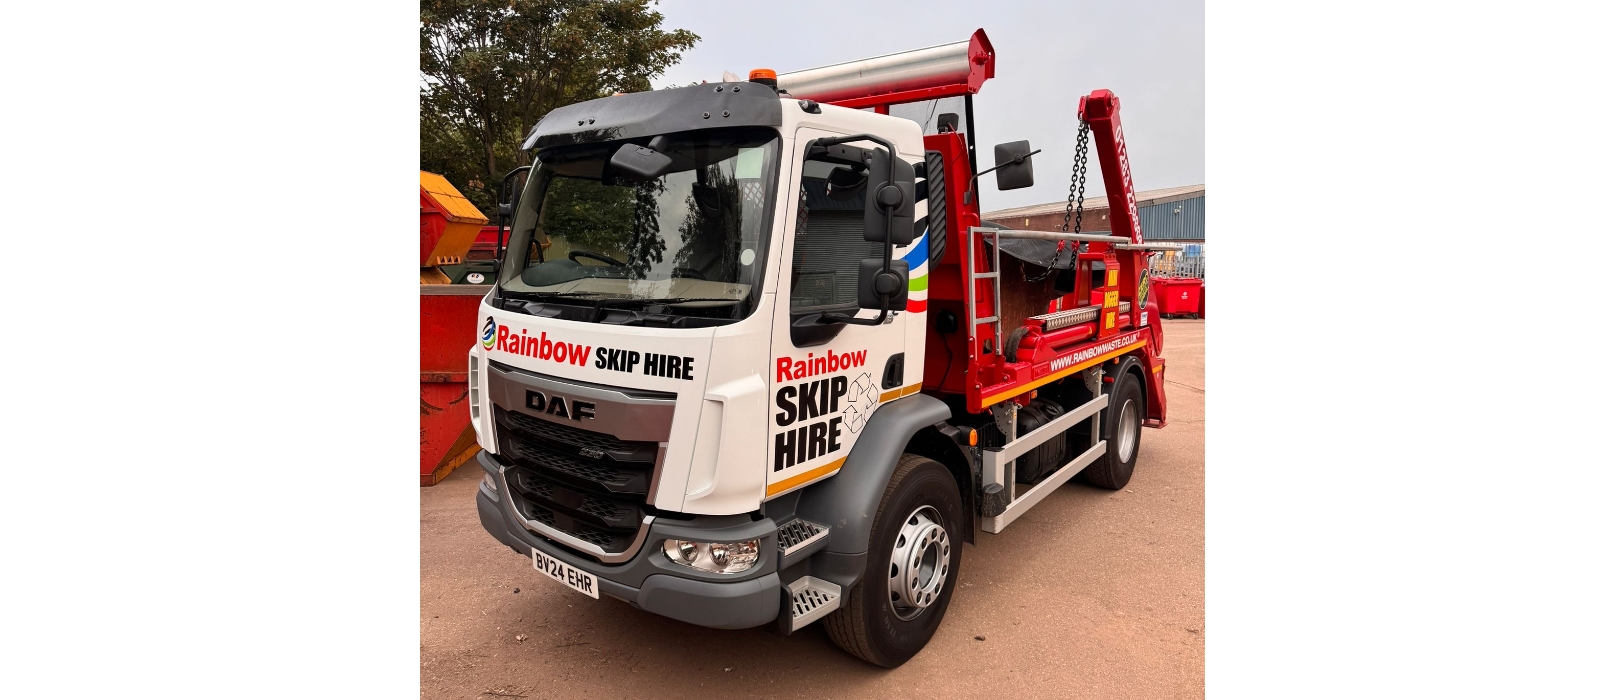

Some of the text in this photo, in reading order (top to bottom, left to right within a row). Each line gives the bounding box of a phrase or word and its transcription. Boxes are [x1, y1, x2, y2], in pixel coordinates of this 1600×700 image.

[496, 325, 695, 381] Rainbow SKIP HIRE
[776, 349, 867, 383] Rainbow
[525, 388, 596, 421] DAF
[775, 375, 848, 427] SKIP
[773, 415, 843, 473] HIRE
[535, 551, 593, 594] BV24 EHR
